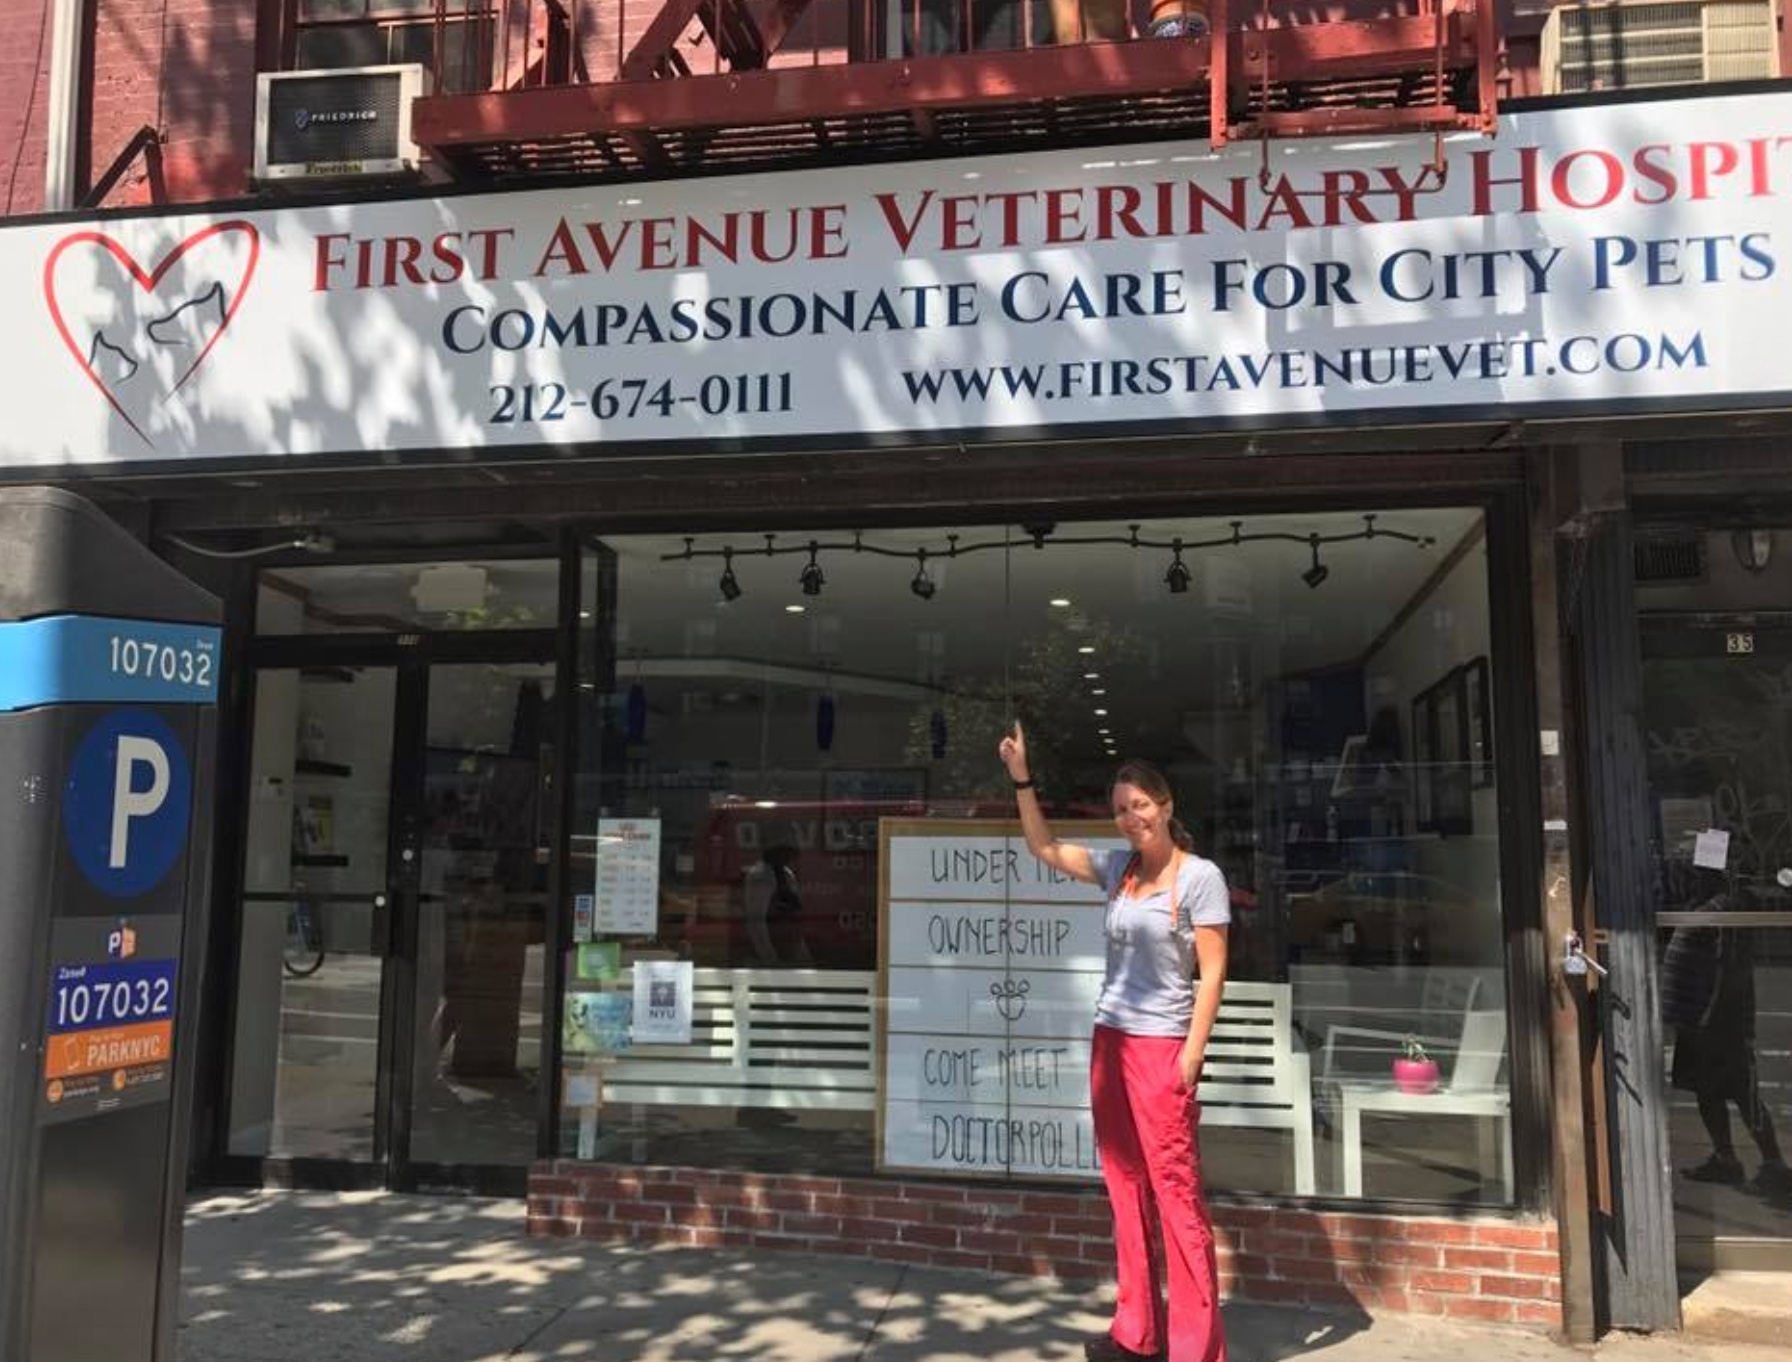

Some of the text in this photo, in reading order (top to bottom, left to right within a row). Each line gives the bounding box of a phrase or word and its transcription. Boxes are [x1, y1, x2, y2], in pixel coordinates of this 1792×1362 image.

[312, 228, 515, 292] FIRST
[535, 203, 849, 277] AVENUE
[874, 164, 1440, 253] VETERINARY
[442, 232, 1777, 354] COMPASSIONATE CARE FOR CITY PETS
[903, 330, 1709, 407] WWW.FIRSTAVENUEVET.COM
[489, 371, 793, 424] 212-674-0111
[110, 636, 211, 686] 107032
[109, 734, 171, 868] P
[931, 849, 1018, 883] UNDER
[927, 914, 1071, 957] OWNERSHIP
[57, 977, 170, 1025] 107032
[87, 1035, 162, 1067] PARKNYC
[923, 1047, 1069, 1090] COME MEET
